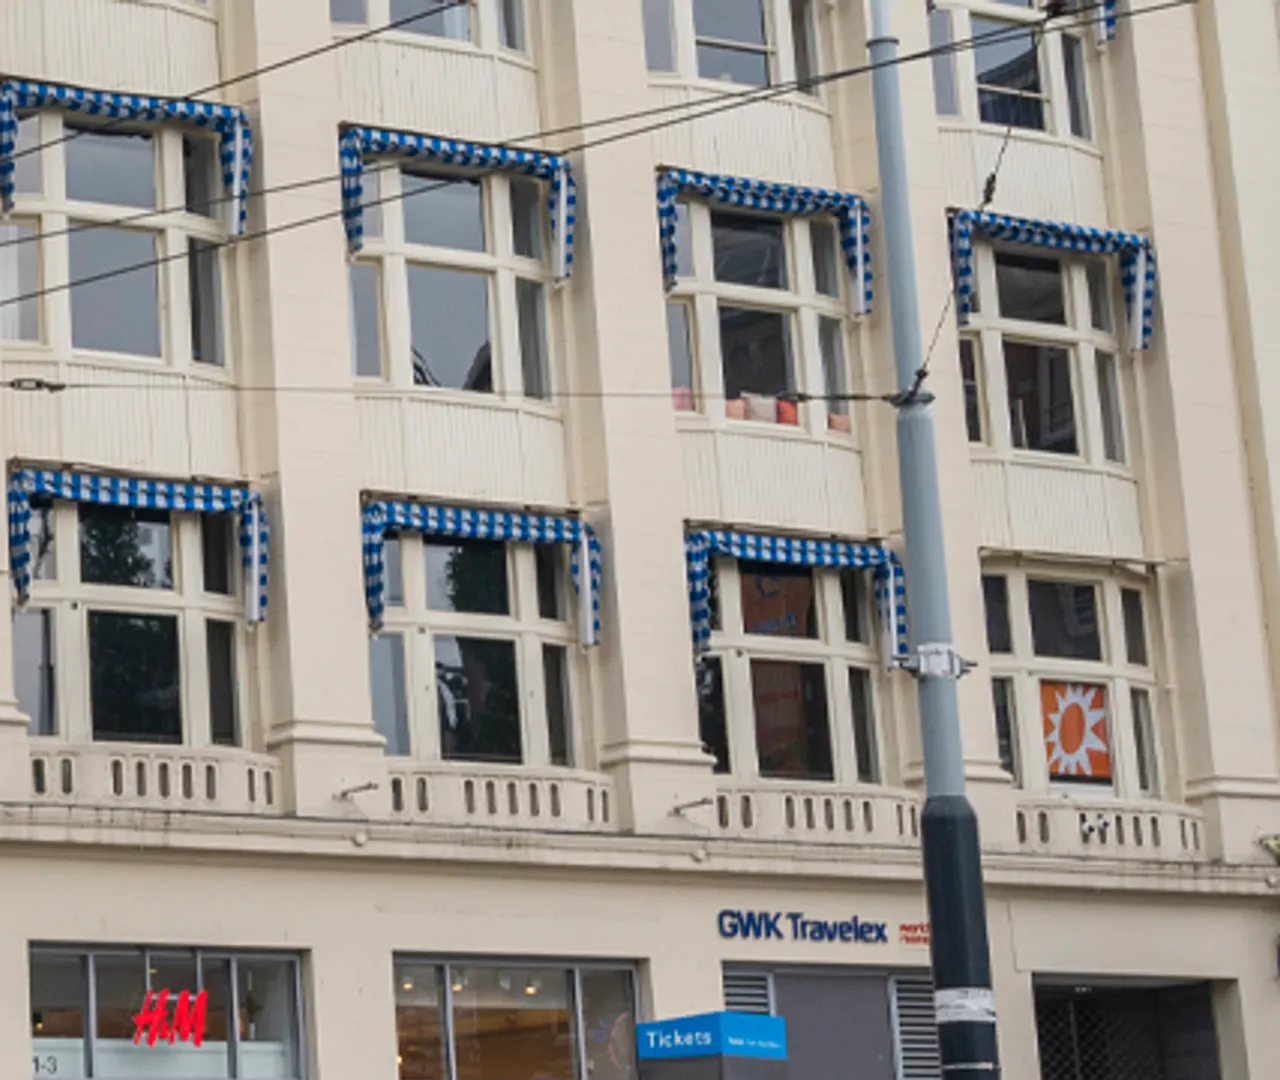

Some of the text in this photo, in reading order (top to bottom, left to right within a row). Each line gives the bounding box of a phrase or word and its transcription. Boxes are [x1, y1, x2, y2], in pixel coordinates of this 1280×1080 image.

[717, 909, 888, 943] GWK Travelex
[131, 987, 208, 1049] H&M
[645, 1029, 712, 1049] Tickets
